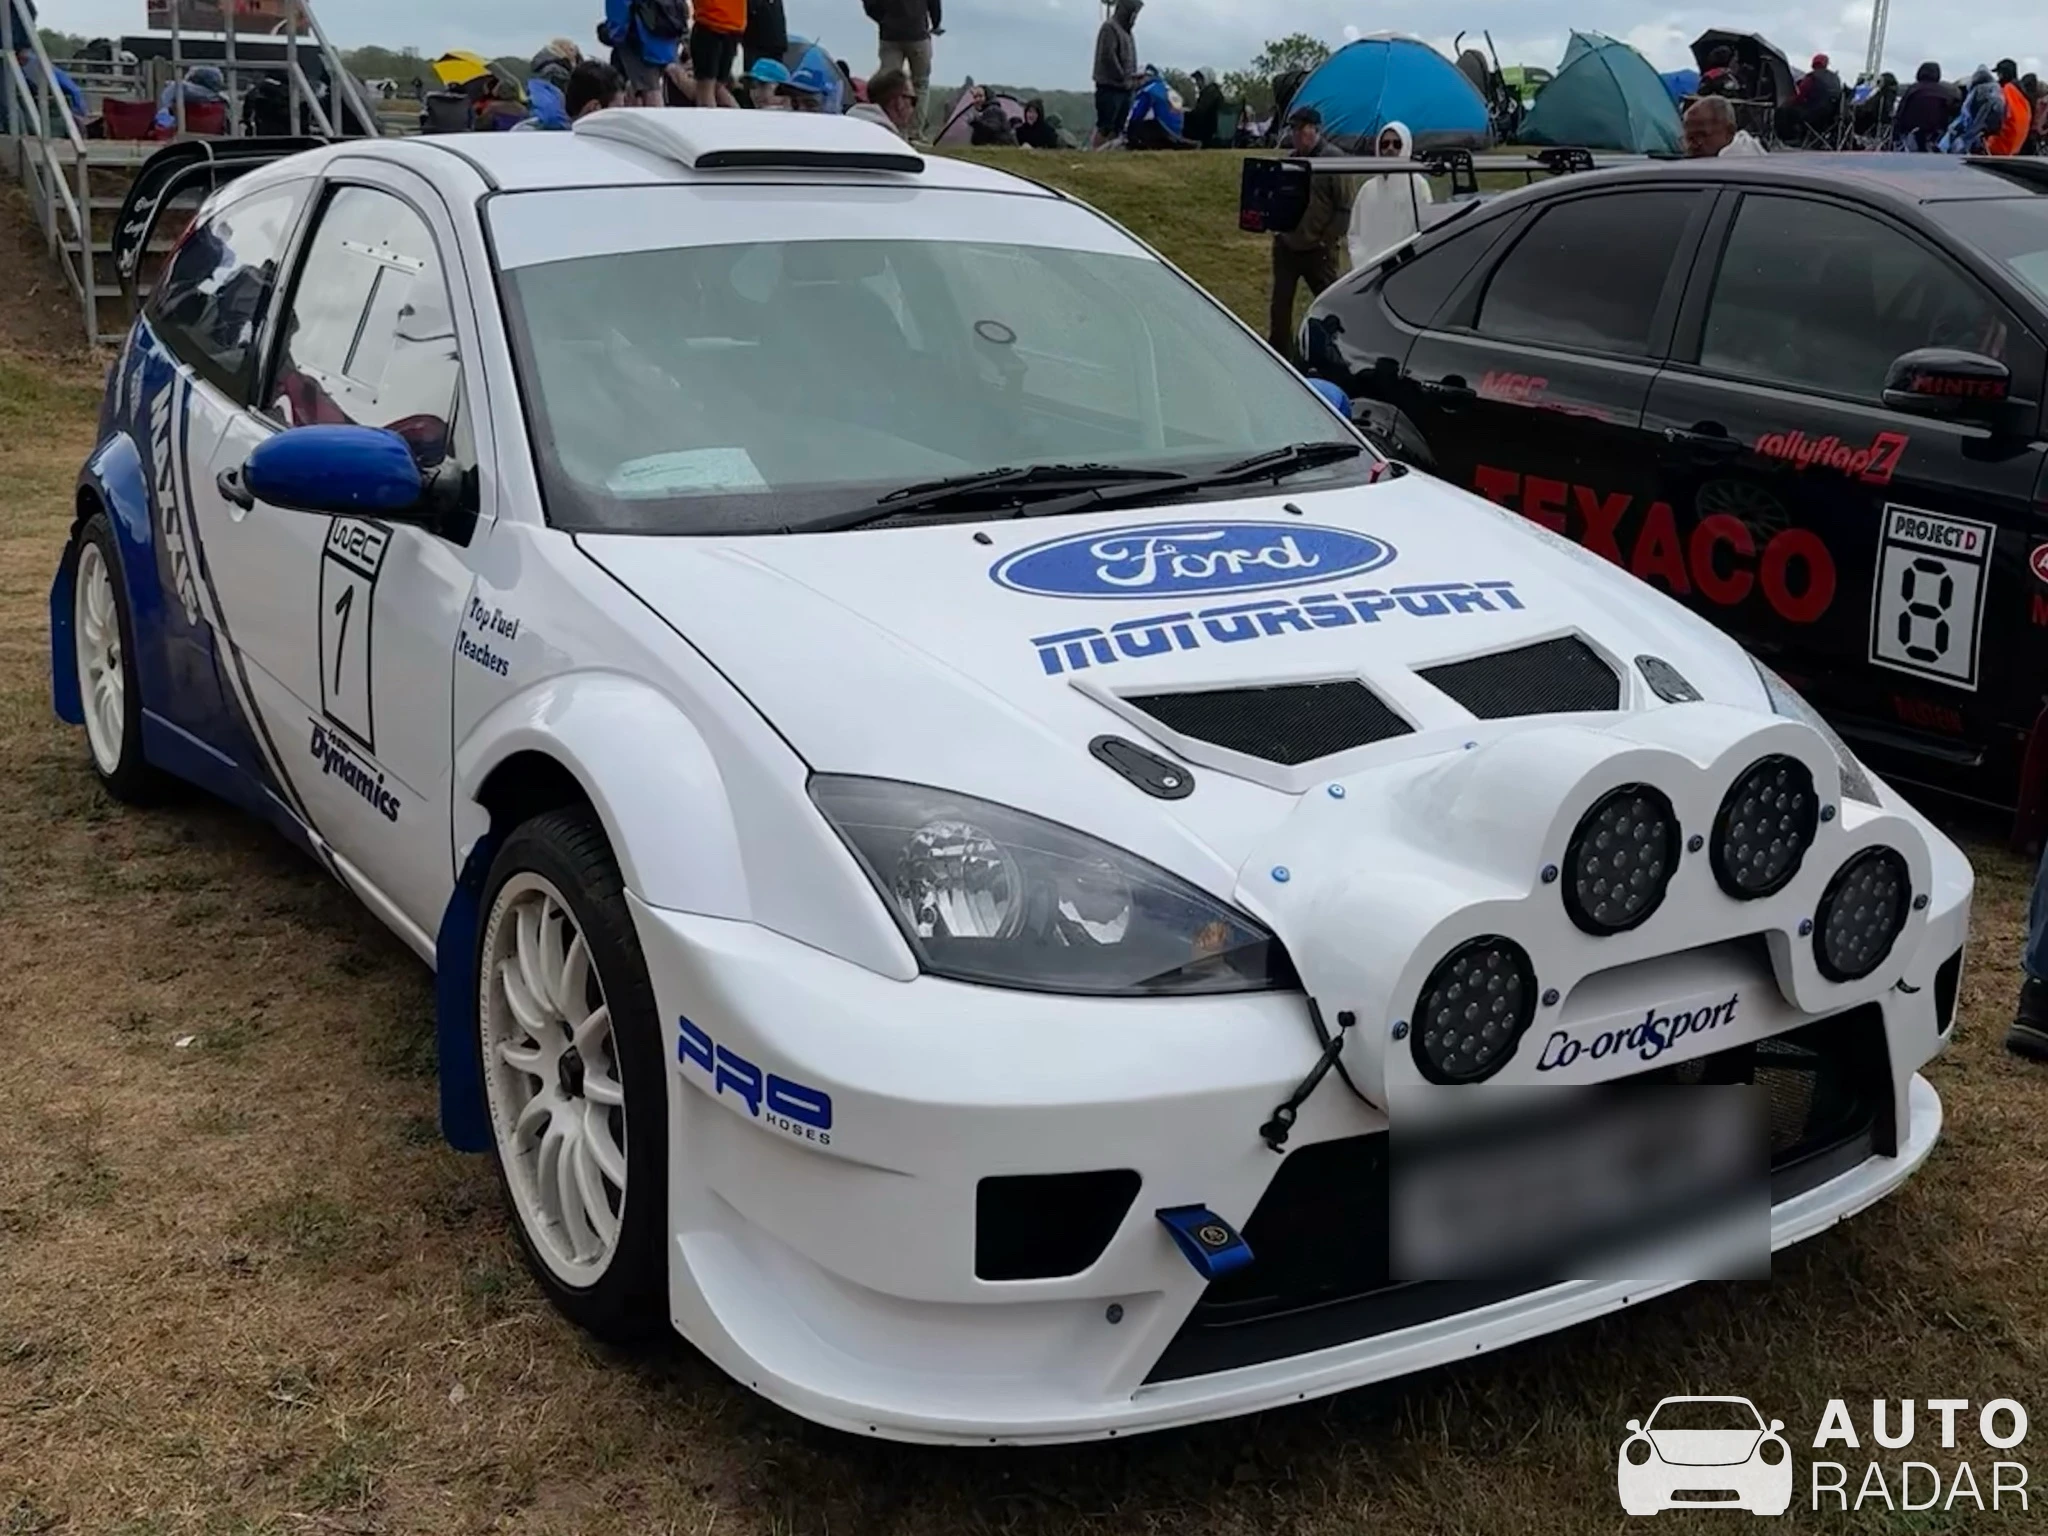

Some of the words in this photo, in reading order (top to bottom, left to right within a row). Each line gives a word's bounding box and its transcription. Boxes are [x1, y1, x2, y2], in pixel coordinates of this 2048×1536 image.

[1910, 373, 2007, 397] MINTEX
[151, 381, 198, 625] MAXXIS
[1895, 515, 1964, 548] PROJECT
[1964, 530, 1977, 550] D
[1090, 530, 1320, 585] Ford
[335, 584, 354, 695] 1
[469, 597, 491, 628] Top
[490, 607, 519, 641] Fuel
[1030, 581, 1526, 675] MOTORSPORT
[1898, 557, 1954, 663] 8
[457, 631, 510, 677] Teachers
[310, 726, 401, 823] Dynamics
[678, 1014, 832, 1130] PRO
[766, 1112, 830, 1145] HOSES
